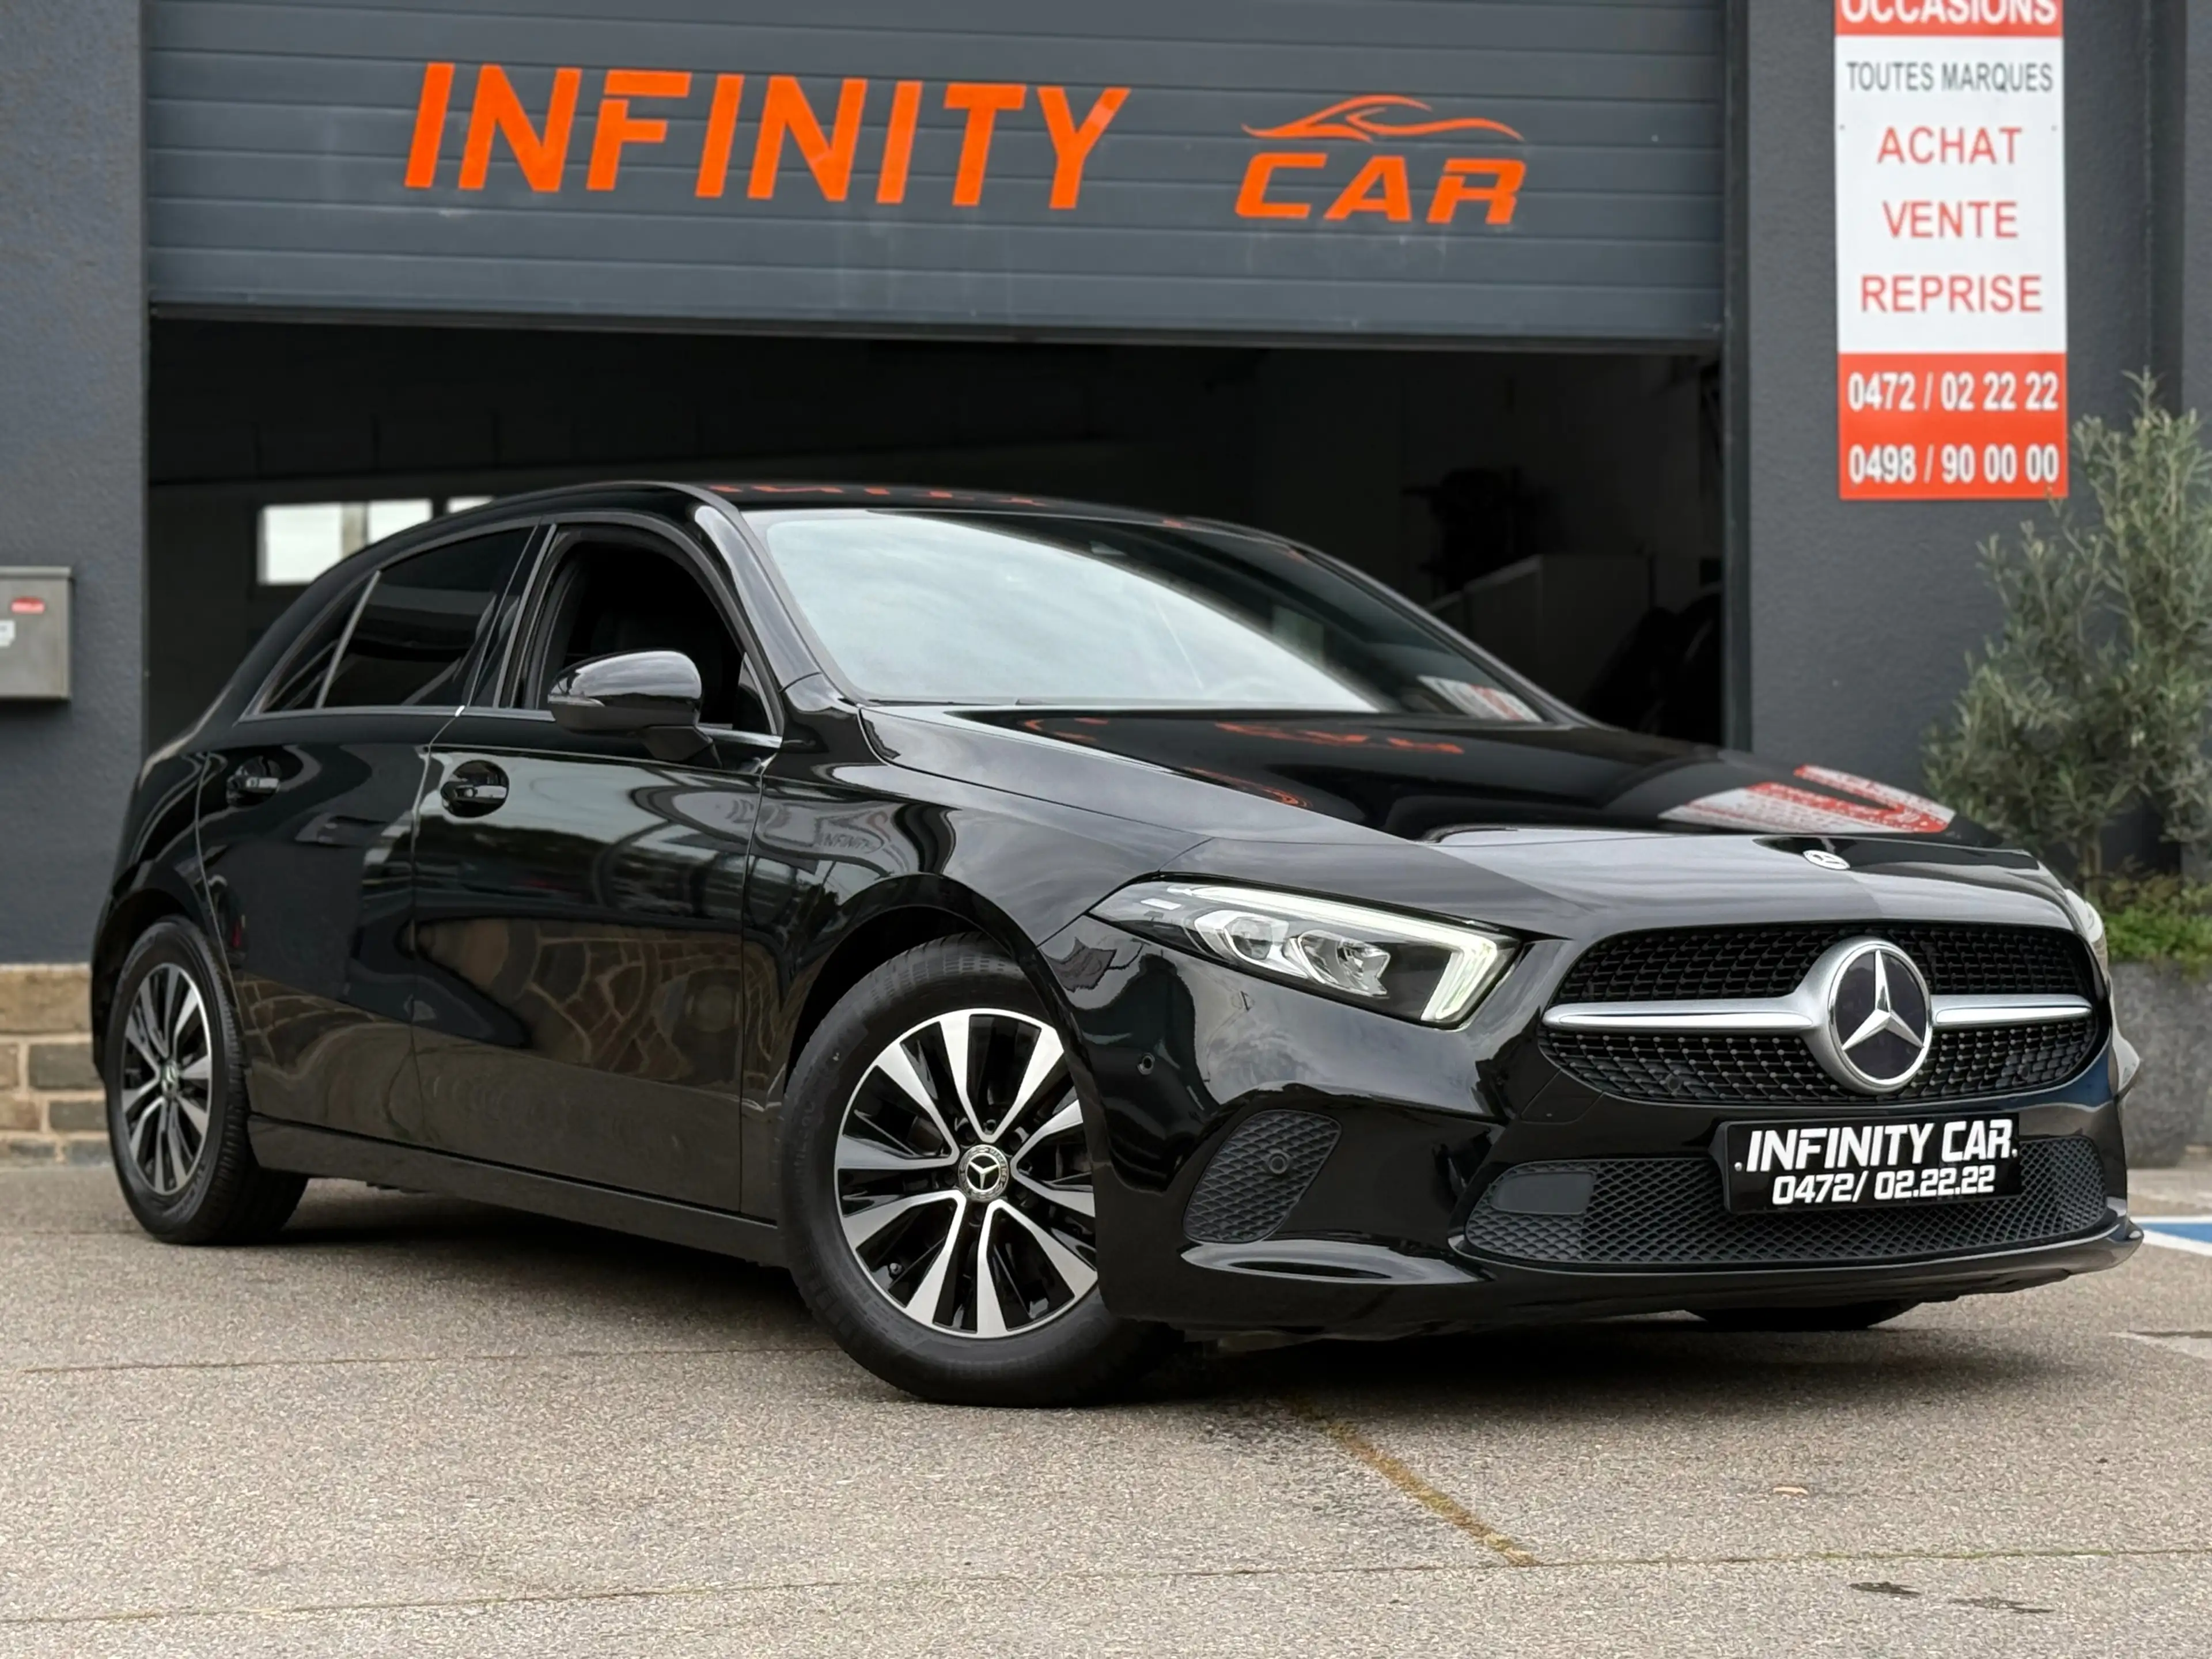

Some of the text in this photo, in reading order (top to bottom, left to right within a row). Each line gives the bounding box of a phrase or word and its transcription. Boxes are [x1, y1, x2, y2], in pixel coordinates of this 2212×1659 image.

[1841, 0, 2057, 24] OCCASIONS
[1847, 62, 2052, 93] TOUTES MARQUES
[404, 62, 1129, 210] INFINITY
[1878, 127, 2021, 164] ACHAT
[1235, 152, 1525, 226] CAR
[1884, 201, 2017, 237] VENTE
[1862, 275, 2042, 312] REPRISE
[1848, 372, 1915, 411] 0472
[1941, 372, 1974, 410] 02
[1983, 372, 2016, 410] 22
[2025, 372, 2058, 410] 22
[1849, 445, 1916, 483] 0498
[1942, 445, 1975, 483] 90
[1984, 445, 2017, 483] 00
[2025, 445, 2058, 483] 00
[1746, 1119, 2013, 1172] INFINITY CAR
[1772, 1165, 1996, 1205] 0472/ 02.22.22
